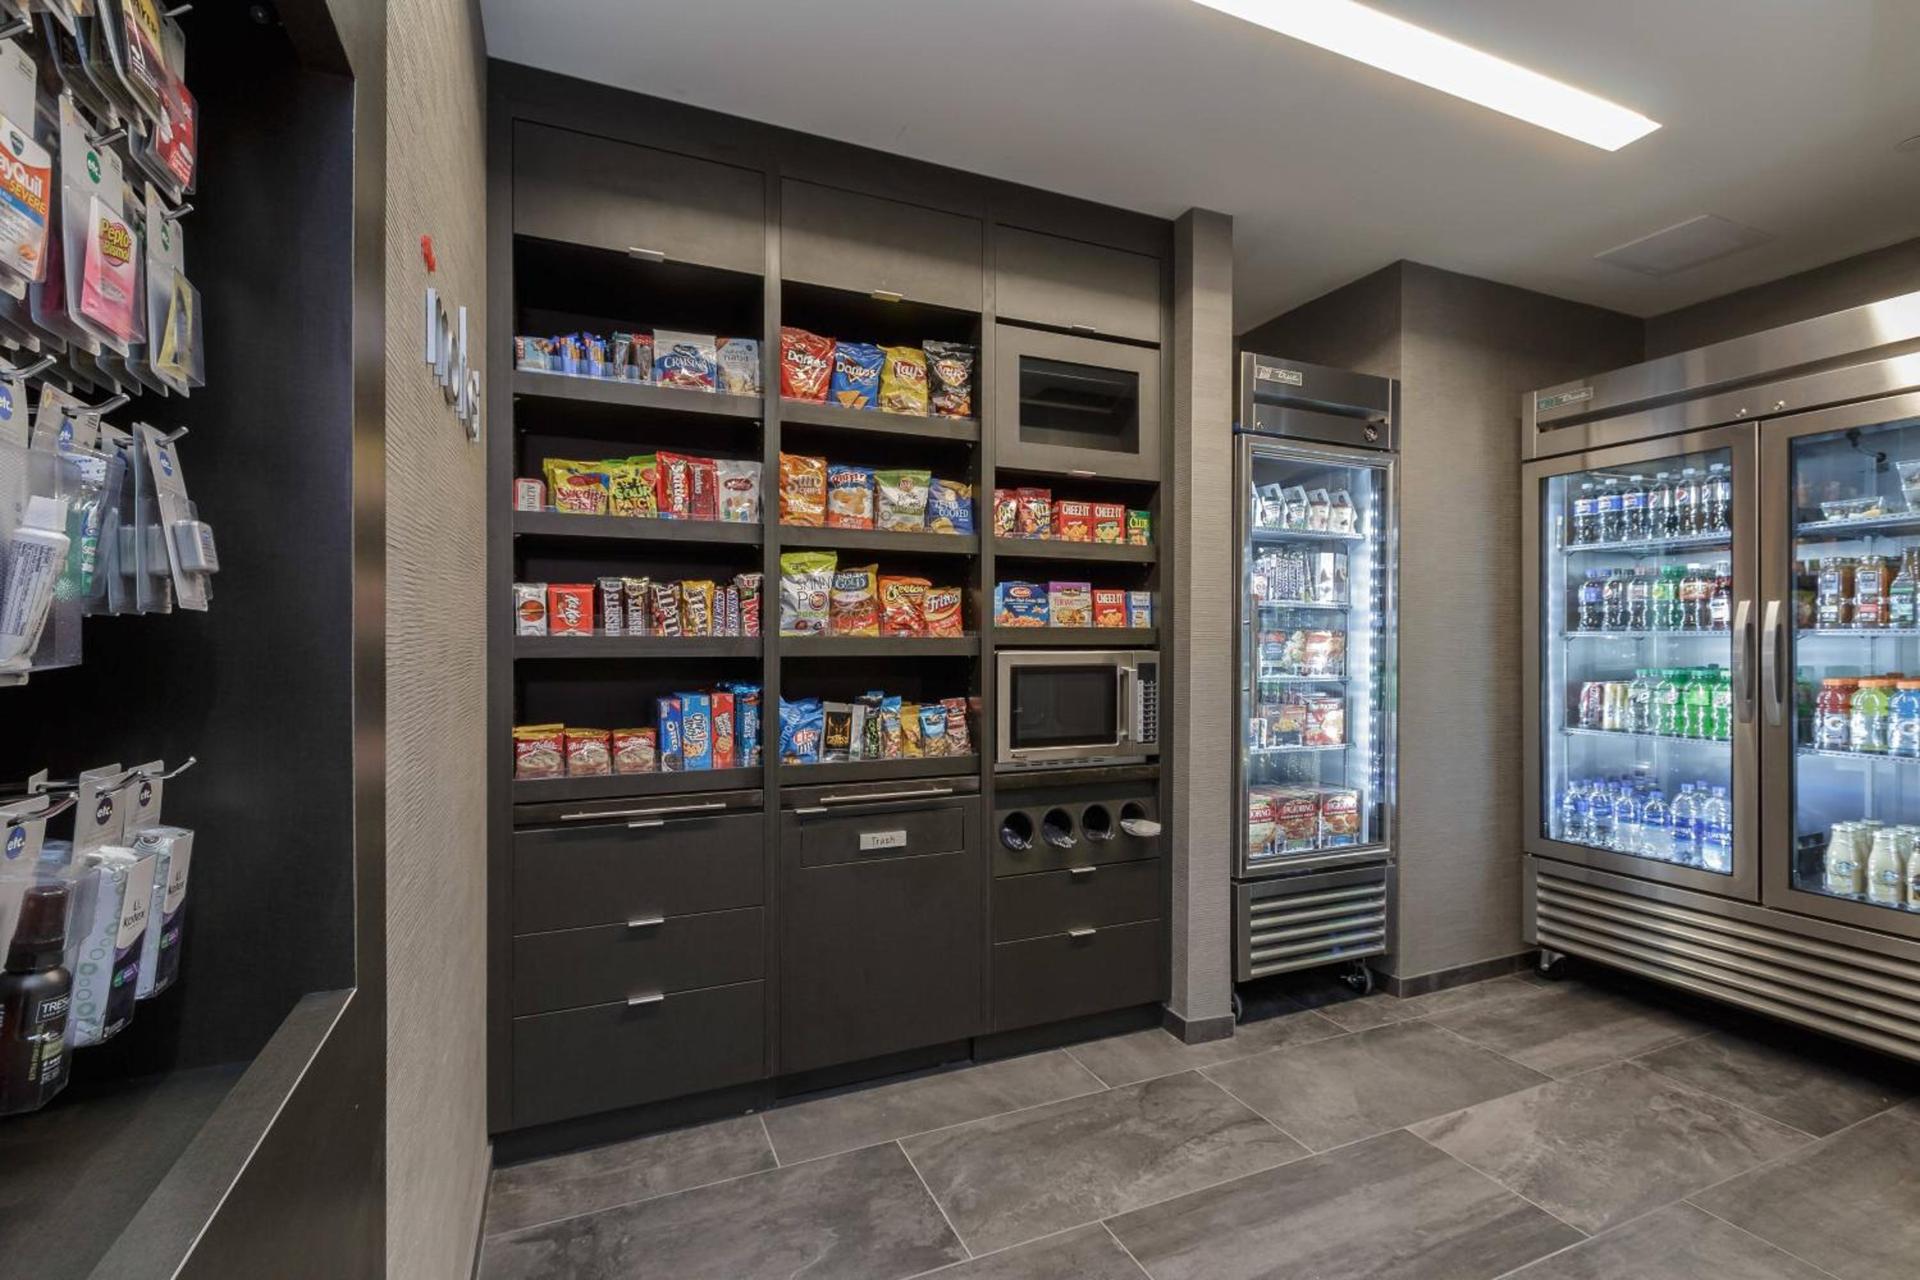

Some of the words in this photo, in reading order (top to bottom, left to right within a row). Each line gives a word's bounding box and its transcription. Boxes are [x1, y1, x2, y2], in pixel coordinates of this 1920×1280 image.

[8, 179, 47, 215] SEVERE
[788, 350, 827, 369] Doritos
[836, 361, 876, 378] Doritos
[556, 486, 608, 502] Swedish
[616, 486, 652, 499] SOUR
[569, 499, 600, 512] Fish
[666, 721, 678, 752] OREO
[97, 805, 113, 818] etc.
[7, 836, 25, 851] etc.
[872, 835, 896, 848] Trash
[123, 910, 146, 928] Kotex
